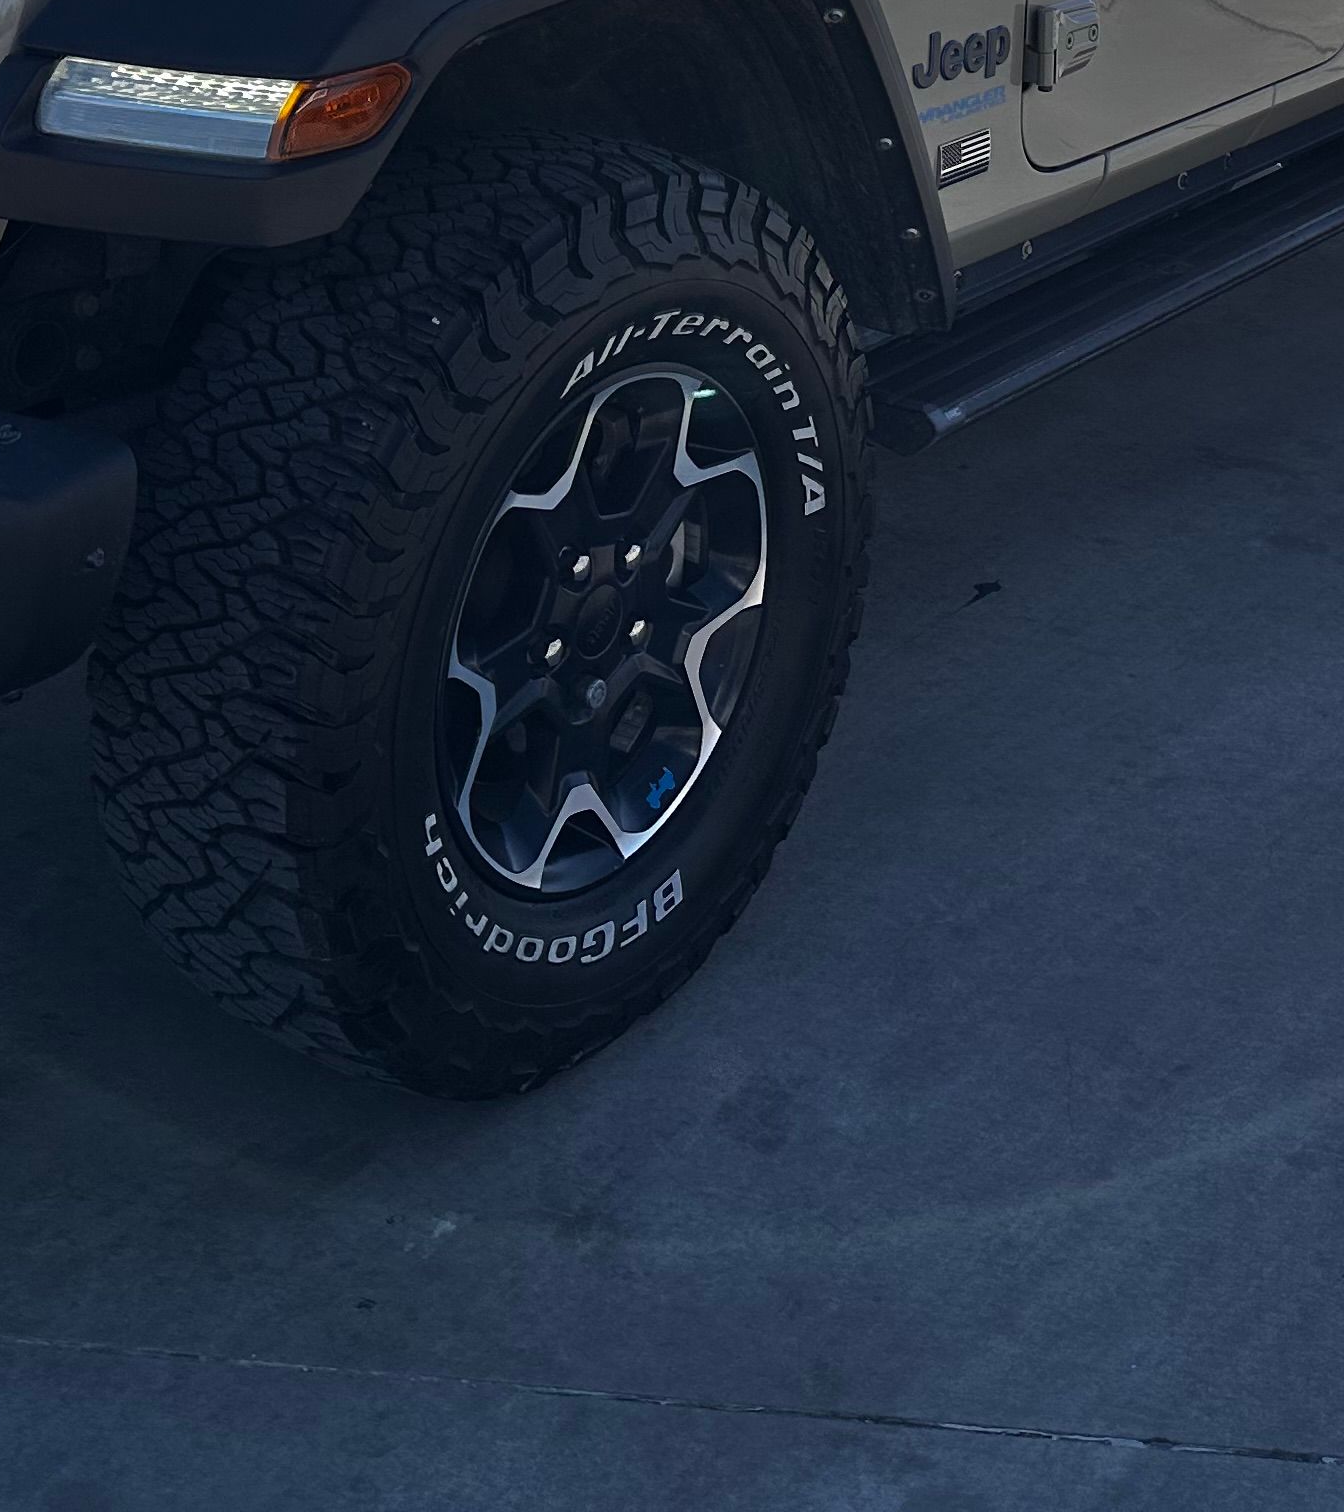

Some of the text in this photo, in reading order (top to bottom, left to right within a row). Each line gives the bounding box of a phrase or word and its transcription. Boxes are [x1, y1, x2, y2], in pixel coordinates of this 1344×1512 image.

[912, 24, 1011, 89] Jeep
[560, 308, 826, 516] All-Terrain T/A
[424, 812, 684, 965] BFGoodrich
